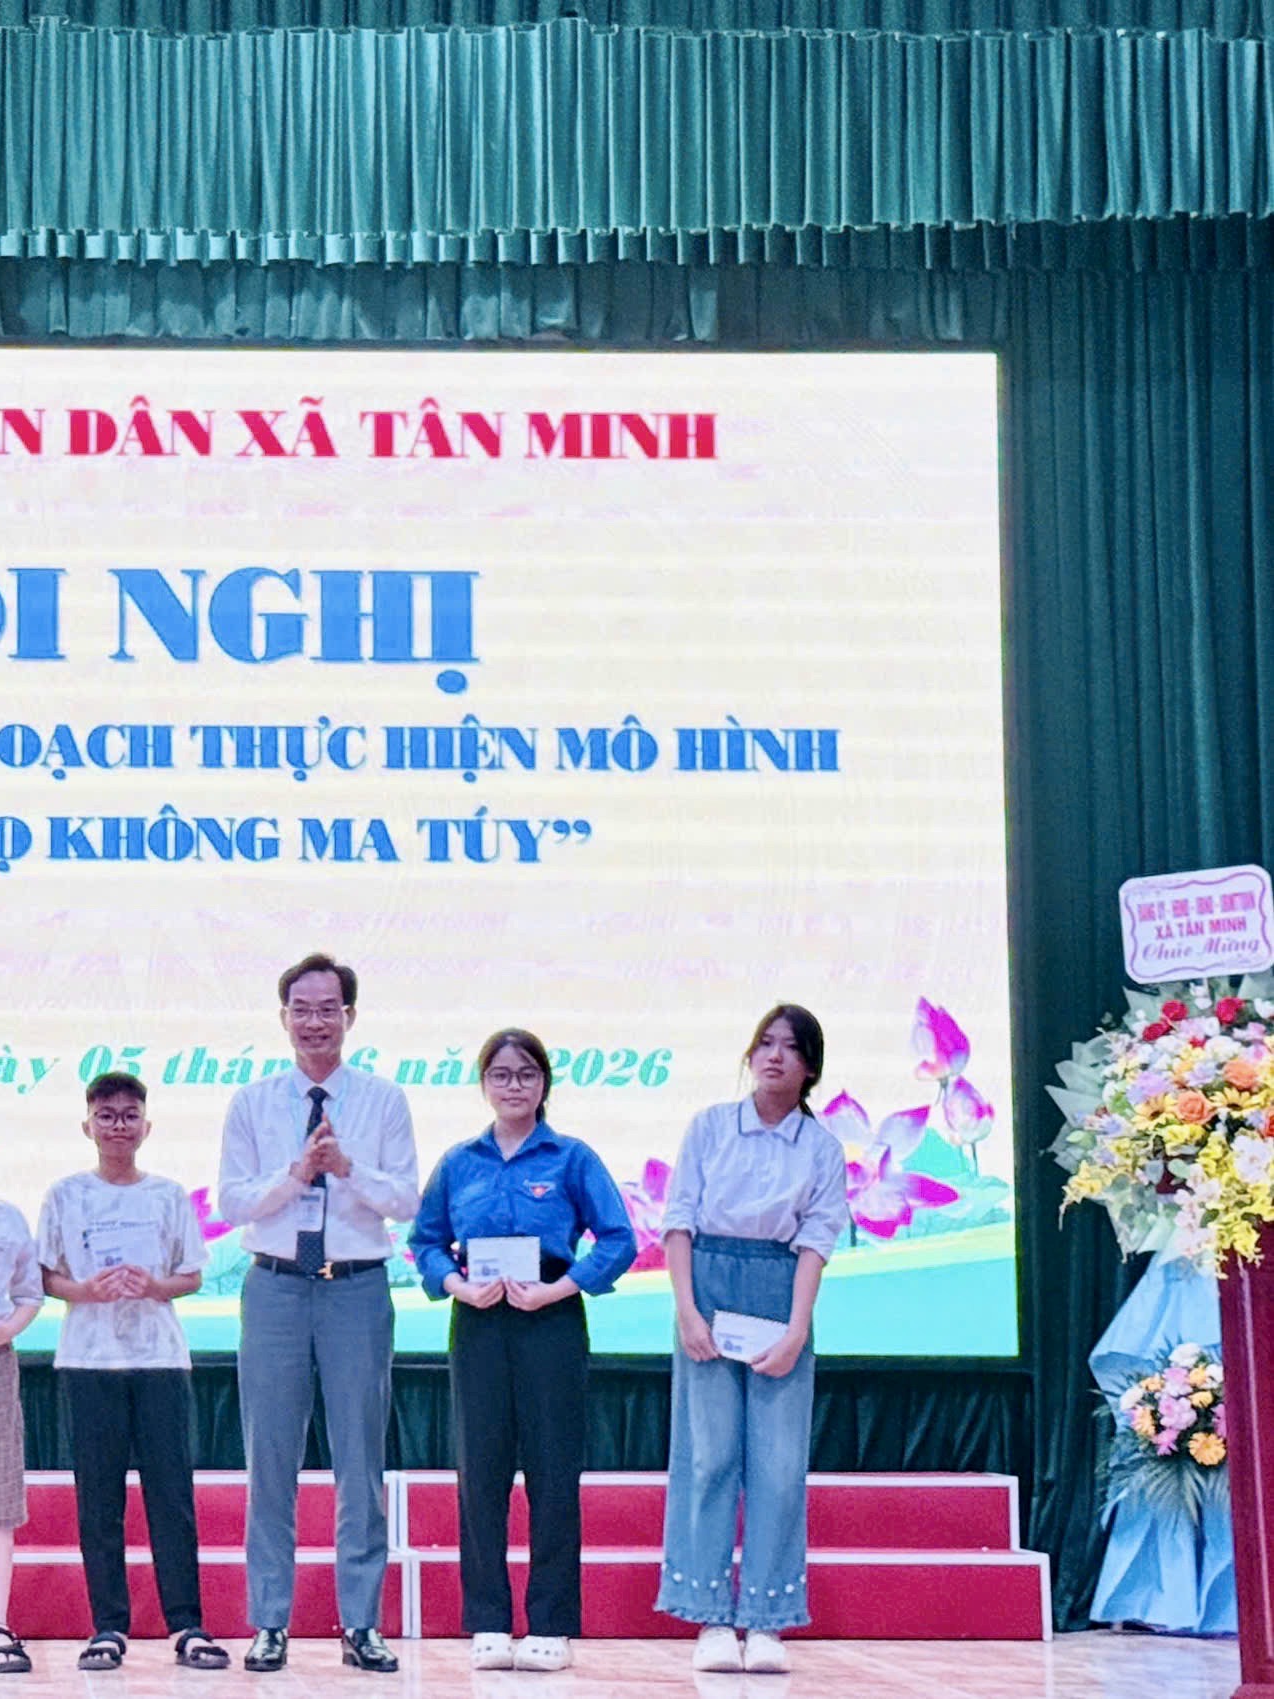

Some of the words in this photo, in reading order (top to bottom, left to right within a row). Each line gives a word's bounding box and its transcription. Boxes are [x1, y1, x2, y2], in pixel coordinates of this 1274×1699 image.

[66, 397, 212, 456] DÂN
[236, 397, 340, 458] XÃ
[360, 398, 504, 459] TÂN
[525, 412, 716, 460] MINH
[108, 568, 480, 694] NGHỊ
[189, 716, 367, 782] THỰC
[383, 714, 537, 783] HIỆN
[556, 715, 660, 773] MÔ
[675, 715, 840, 773] HÌNH
[47, 804, 281, 863] KHÔNG
[299, 817, 401, 863] MA
[1209, 916, 1247, 934] MINH
[77, 1046, 147, 1083] 05
[394, 1046, 482, 1085] nă
[548, 1048, 673, 1087] 2026
